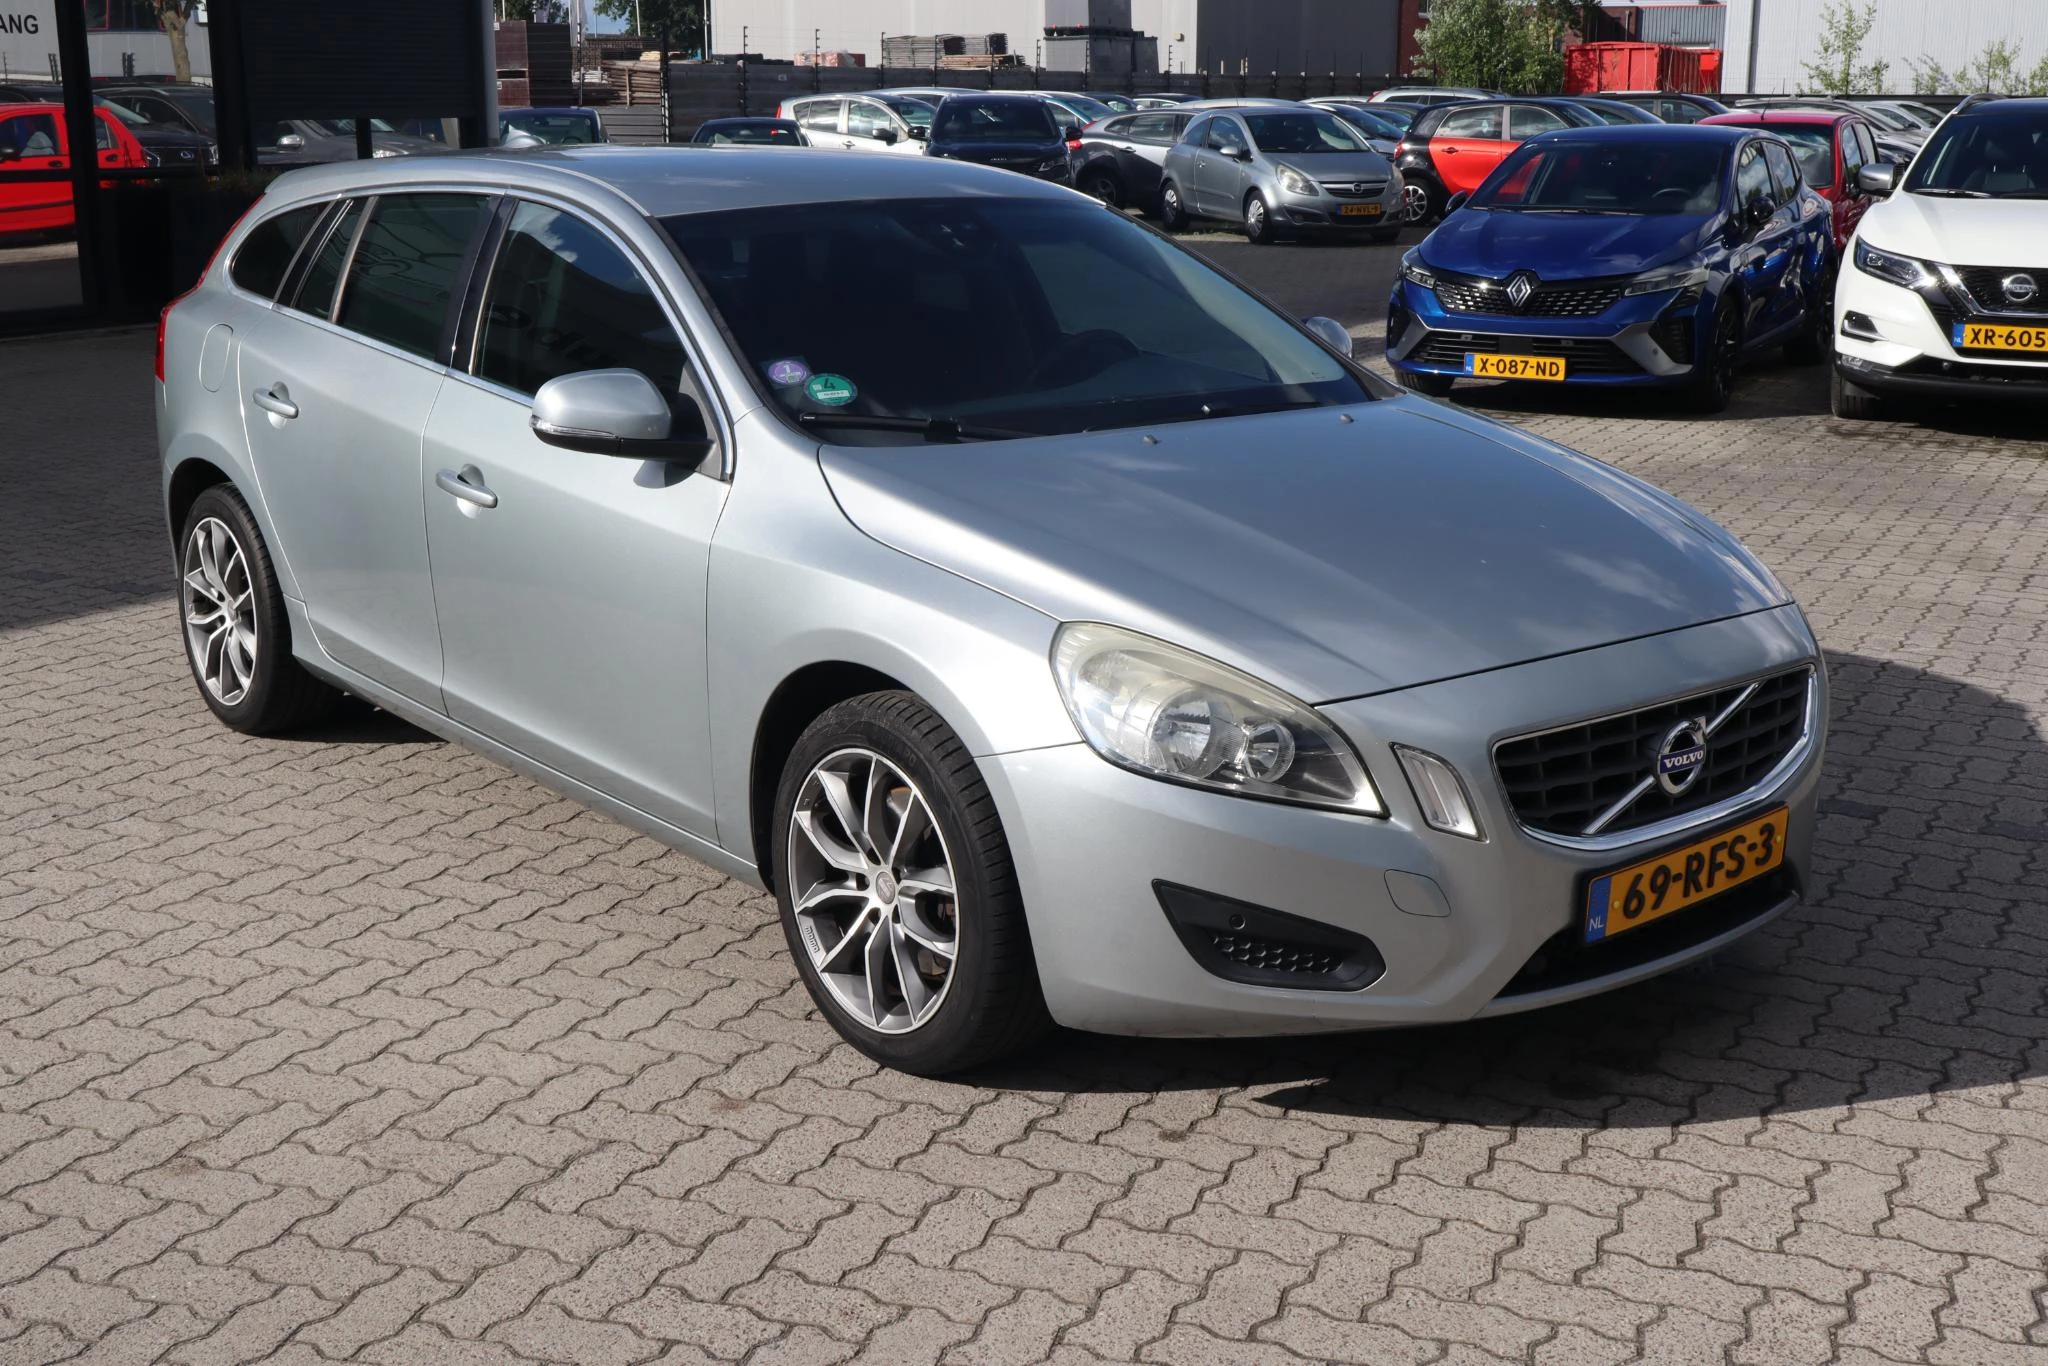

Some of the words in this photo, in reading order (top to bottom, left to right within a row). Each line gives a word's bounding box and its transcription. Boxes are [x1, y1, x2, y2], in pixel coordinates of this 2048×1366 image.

[1479, 357, 1560, 377] X-087-ND
[1663, 750, 1704, 769] VOLVO
[1588, 915, 1605, 933] NL
[1622, 822, 1776, 920] 69-RFS-3
